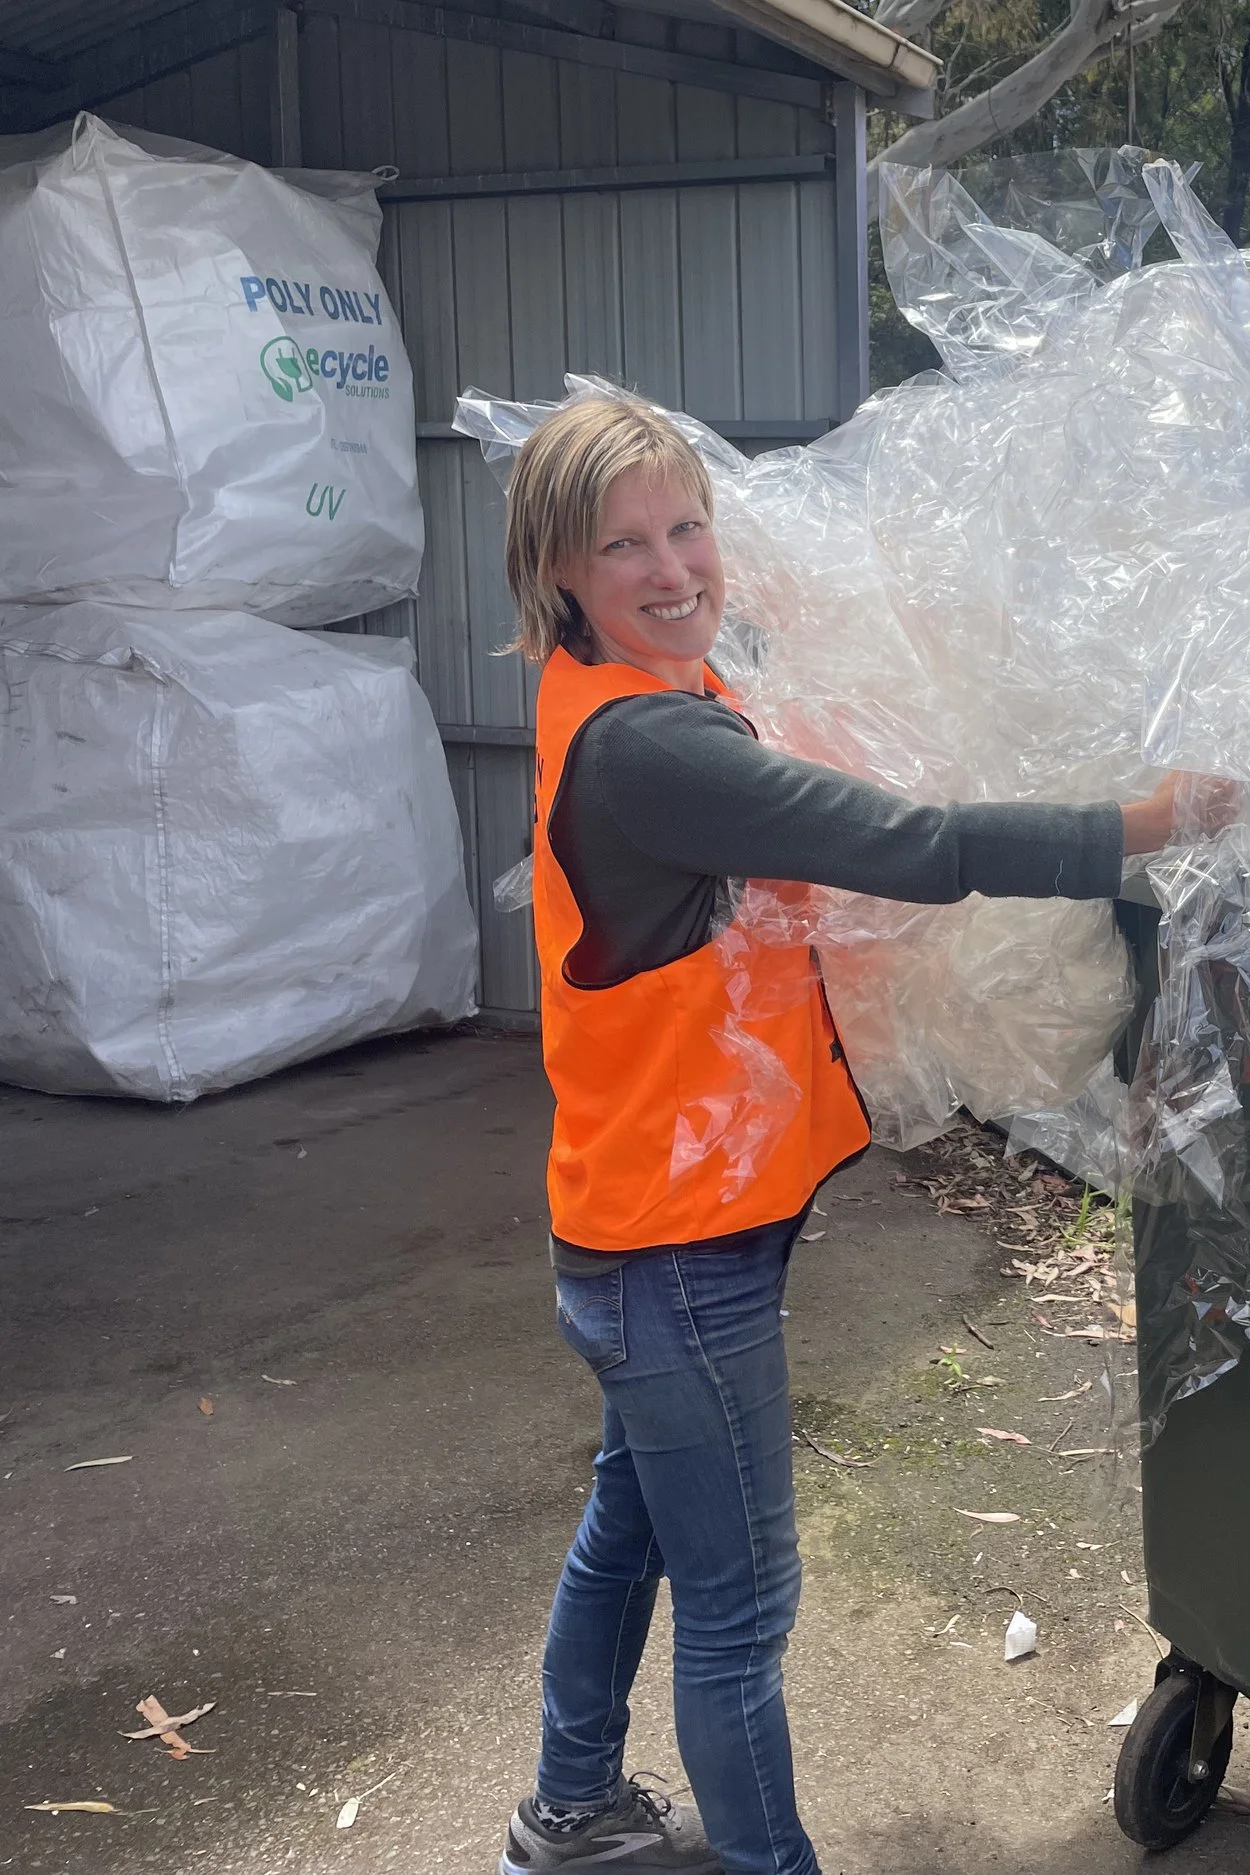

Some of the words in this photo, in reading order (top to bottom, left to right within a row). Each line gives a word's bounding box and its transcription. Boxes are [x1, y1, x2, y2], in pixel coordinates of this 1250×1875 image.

[240, 276, 315, 316] POLY
[319, 286, 383, 326] ONLY
[345, 385, 390, 399] SOLUTIONS
[306, 483, 346, 521] UV
